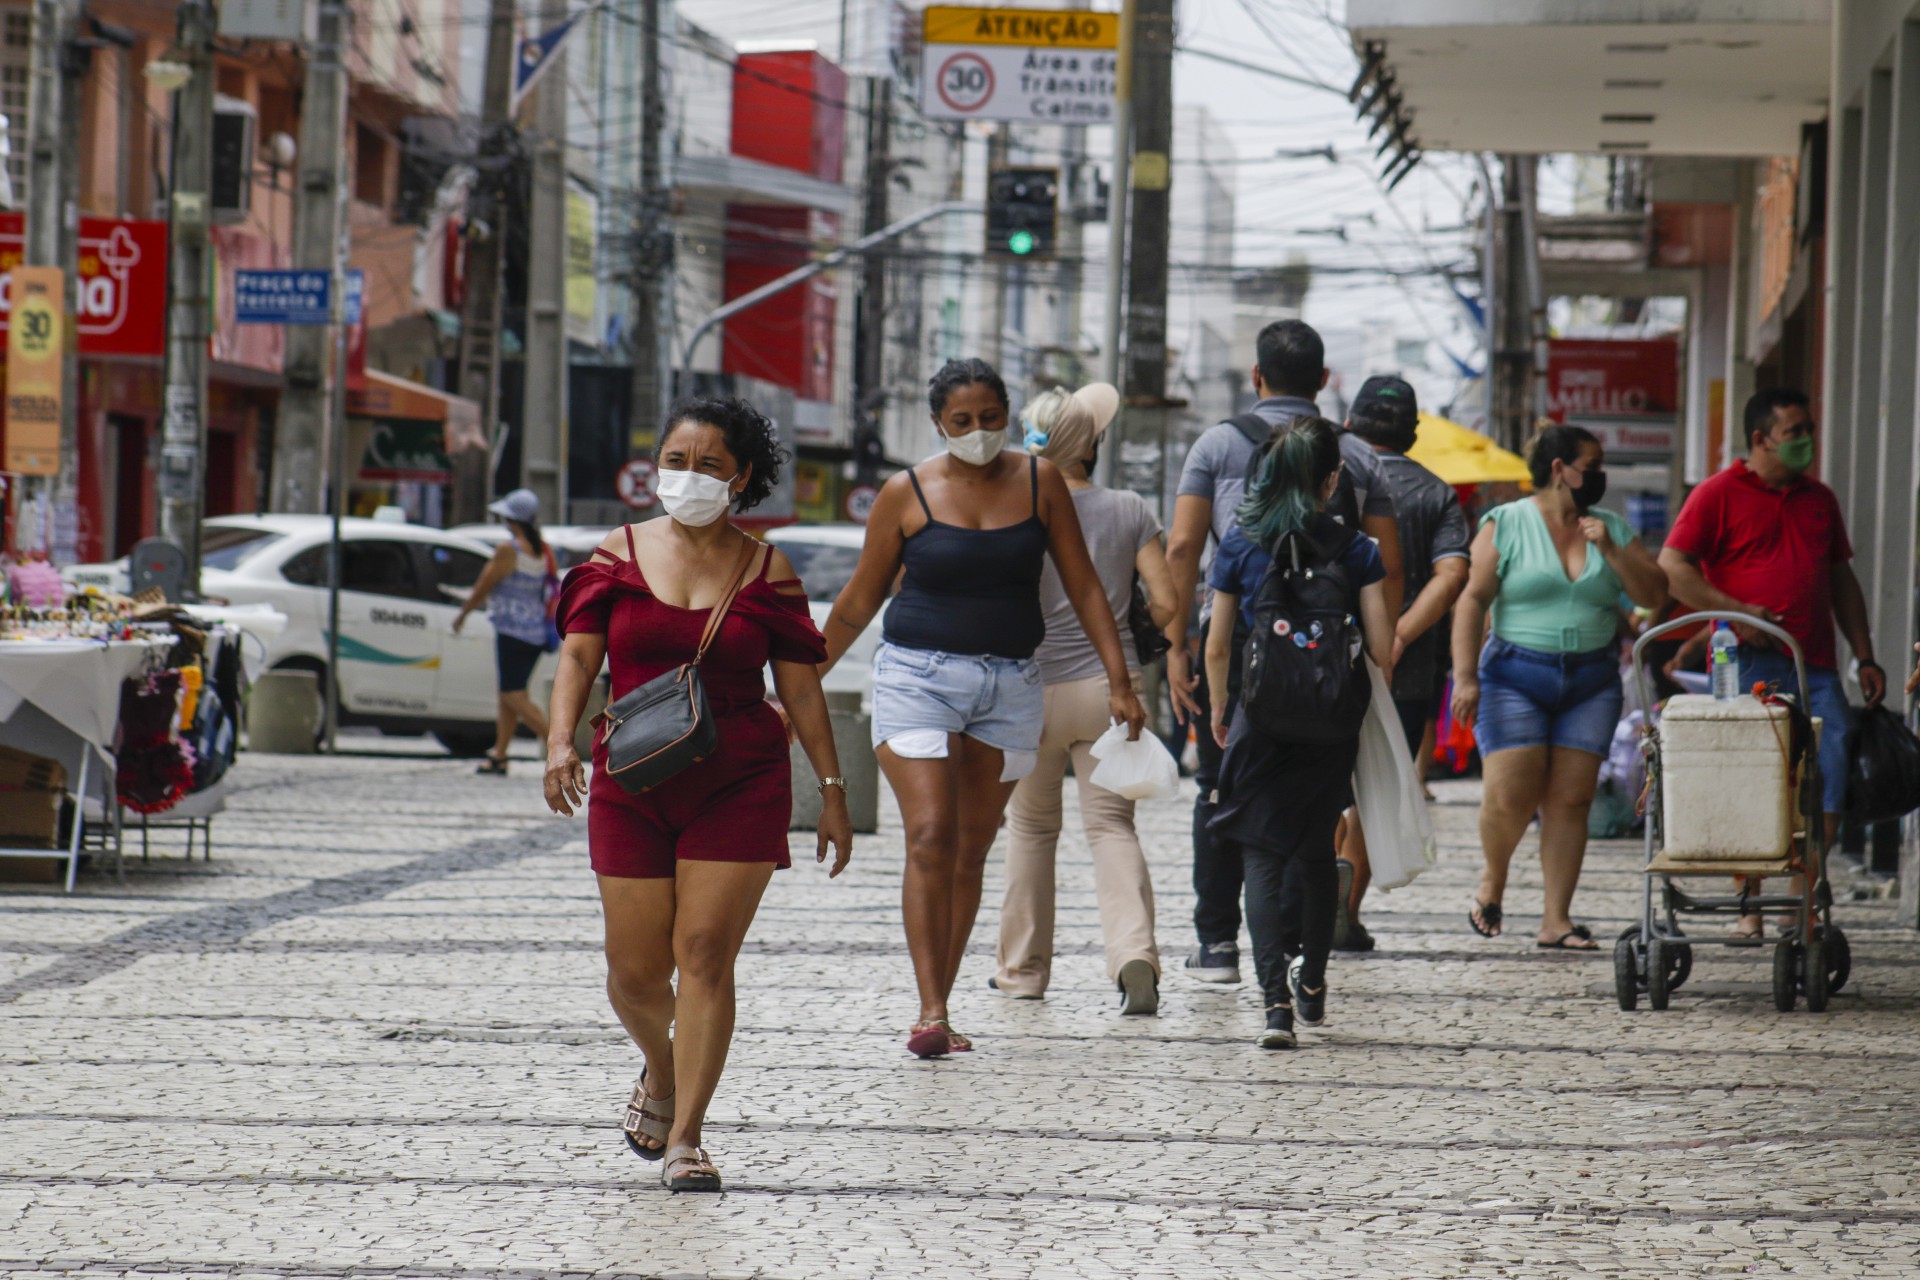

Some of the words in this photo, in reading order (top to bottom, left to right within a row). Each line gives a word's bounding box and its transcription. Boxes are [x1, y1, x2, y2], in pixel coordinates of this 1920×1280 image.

[976, 14, 1101, 42] ATENÇÃO
[1023, 48, 1080, 72] Área
[947, 66, 987, 92] 30
[1030, 98, 1111, 117] Calmo
[238, 275, 293, 293] Praça
[297, 273, 324, 292] do
[238, 294, 318, 309] Ferreira
[22, 310, 51, 340] 30
